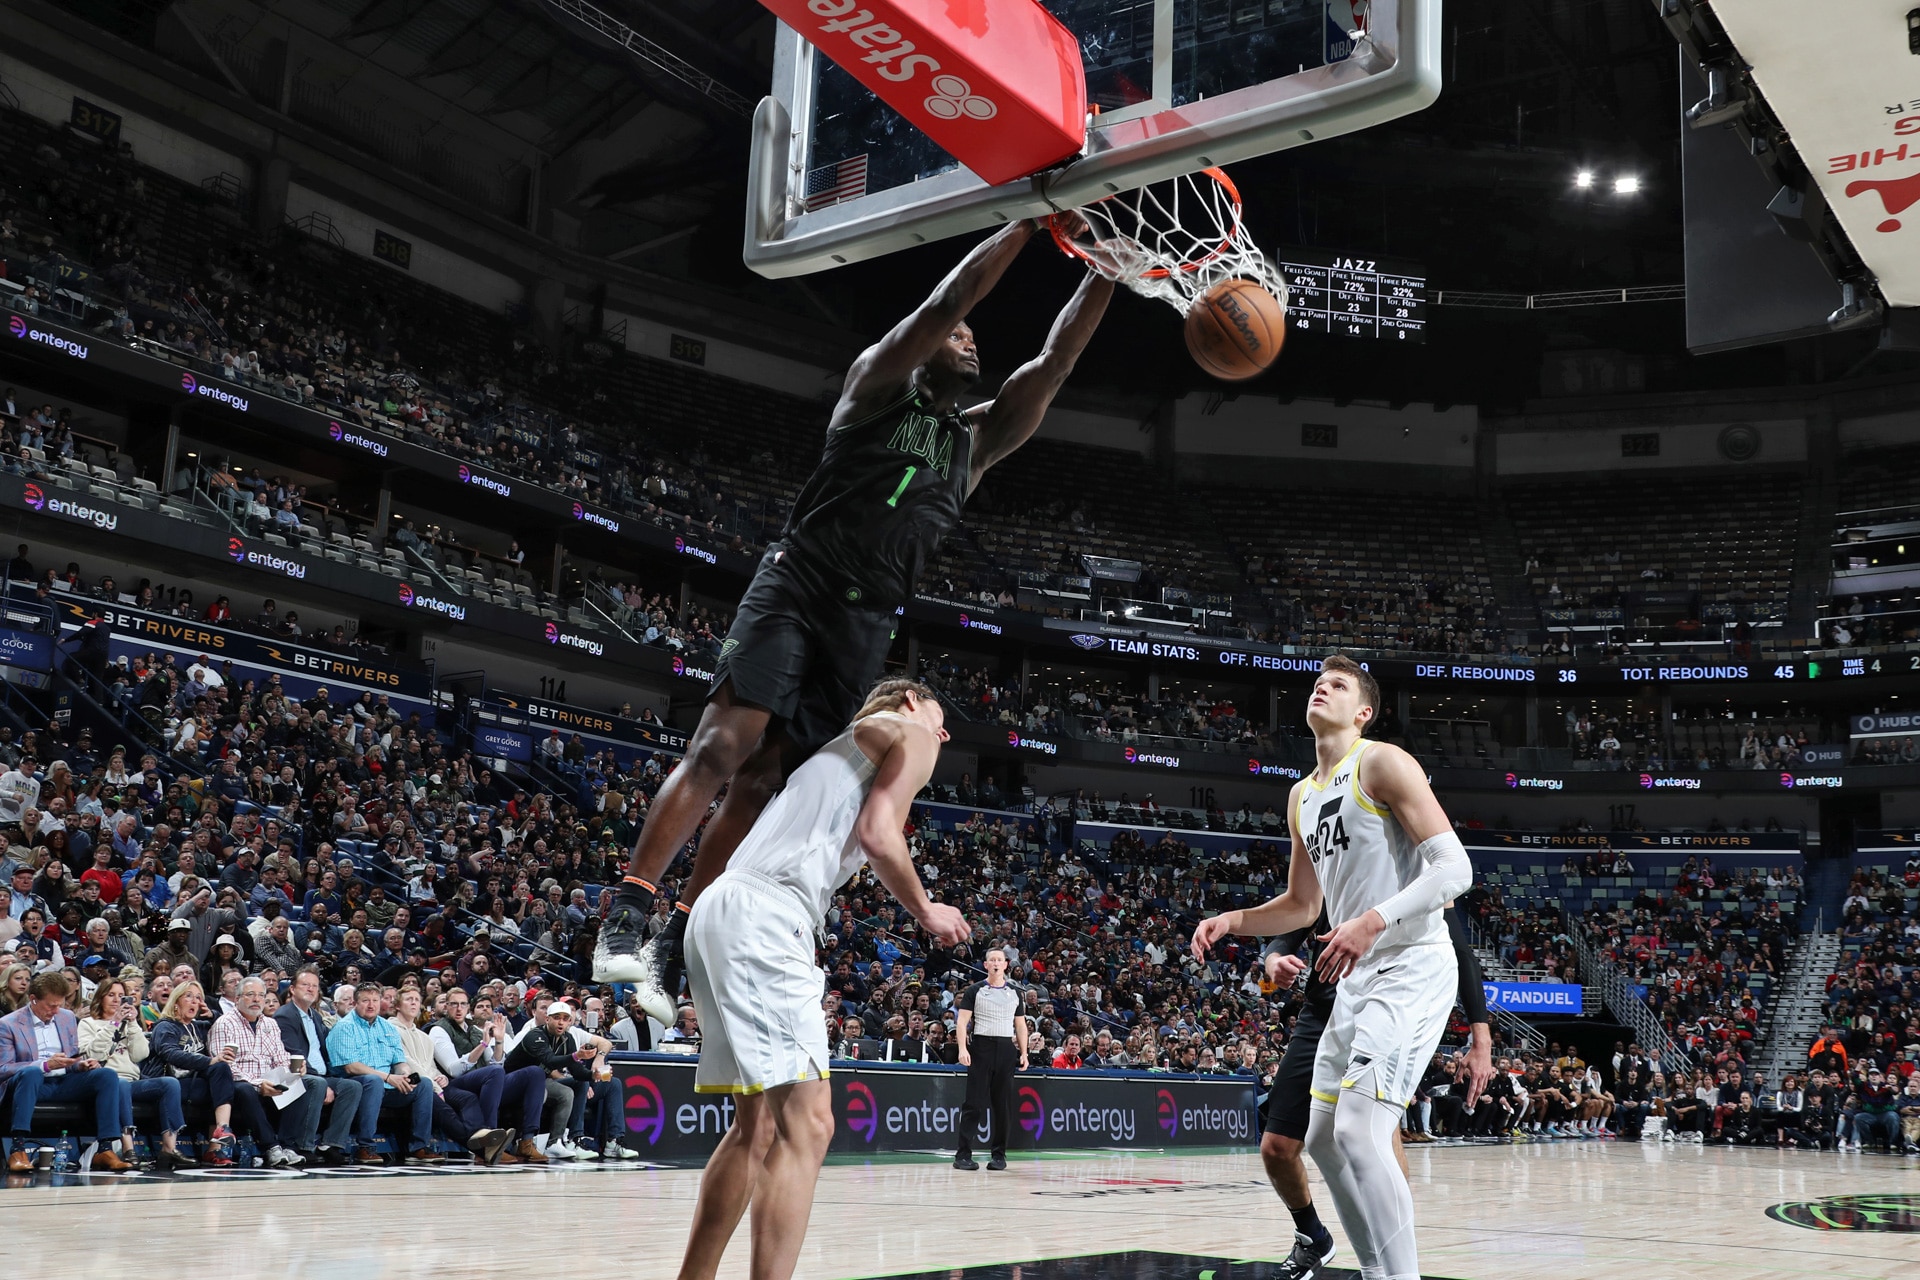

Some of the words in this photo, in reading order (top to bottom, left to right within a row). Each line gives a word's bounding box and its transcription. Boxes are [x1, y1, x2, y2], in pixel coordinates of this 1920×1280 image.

[807, 0, 941, 82] State
[1330, 40, 1352, 60] NBA
[76, 105, 117, 137] 317
[378, 237, 409, 262] 318
[59, 264, 74, 278] 17
[1284, 265, 1303, 274] FIELD
[1304, 268, 1326, 277] GOALS
[1332, 257, 1376, 273] JAZZ
[1294, 276, 1317, 287] 47%
[1331, 271, 1348, 280] FREE
[1350, 273, 1377, 283] THROWS
[1380, 276, 1400, 286] THREE
[1401, 279, 1425, 289] POINTS
[1304, 288, 1320, 296] REB
[1344, 281, 1365, 293] 72%
[1392, 287, 1414, 298] 32%
[1298, 298, 1306, 306] 5
[1356, 294, 1370, 302] REB
[1402, 300, 1417, 308] REB
[1308, 310, 1327, 319] PAINT
[1347, 303, 1361, 313] 23
[1395, 308, 1409, 318] 28
[1216, 291, 1261, 352] Wilson
[1296, 319, 1310, 329] 48
[1333, 314, 1350, 322] FAST
[1351, 316, 1373, 325] BREAK
[1381, 318, 1395, 327] 2ND
[1396, 321, 1422, 330] CHANCE
[1348, 325, 1361, 335] 14
[1398, 330, 1406, 340] 8
[29, 328, 88, 359] entergy
[675, 339, 703, 359] 319
[198, 384, 249, 411] entergy
[344, 432, 388, 457] entergy
[523, 432, 540, 446] 317
[887, 411, 954, 480] NOLA
[574, 451, 591, 464] 318
[471, 473, 511, 497] entergy
[887, 465, 917, 507] 1
[674, 487, 689, 499] 318
[48, 498, 118, 531] entergy
[584, 511, 619, 533] entergy
[685, 544, 717, 564] entergy
[247, 549, 306, 579] entergy
[1065, 577, 1082, 586] 320
[1173, 590, 1189, 600] 320
[415, 595, 466, 621] entergy
[1595, 609, 1613, 618] 322
[103, 611, 226, 649] BETRIVERS
[969, 620, 1002, 635] entergy
[2, 638, 34, 651] GOOSE
[425, 640, 436, 652] 114
[559, 633, 604, 656] entergy
[1108, 638, 1149, 655] TEAM
[1152, 643, 1200, 661] STATS:
[1219, 651, 1249, 666] OFF.
[1253, 655, 1322, 672] REBOUND
[293, 653, 400, 686] BETRIVERS
[1620, 667, 1654, 681] TOT.
[1659, 666, 1749, 680] REBOUNDS
[1774, 665, 1795, 679] 45
[1842, 658, 1865, 668] TIME
[1870, 659, 1882, 673] 4
[1842, 667, 1865, 676] OUTS
[20, 670, 39, 686] 113
[685, 666, 716, 684] enter
[1415, 665, 1447, 679] DEF.
[1451, 667, 1536, 682] REBOUNDS
[1557, 669, 1577, 683] 36
[539, 675, 566, 702] 114
[528, 703, 614, 732] BETRIVERS
[1879, 716, 1910, 728] HUB
[485, 735, 501, 744] GREY
[501, 738, 521, 748] GOOSE
[1020, 738, 1057, 755] entergy
[1138, 752, 1180, 768] entergy
[1819, 751, 1842, 760] HUB
[1261, 764, 1301, 779] entergy
[1519, 777, 1564, 790] entergy
[1654, 775, 1701, 790] entergy
[1795, 774, 1843, 789] entergy
[1190, 786, 1215, 808] 116
[1608, 804, 1636, 823] 117
[1320, 815, 1350, 857] 24
[1521, 835, 1609, 845] BETRIVERS
[1660, 836, 1751, 846] BETRIVERS
[1502, 990, 1574, 1005] FANDUEL
[885, 1099, 991, 1144] entery
[1051, 1102, 1136, 1142] entergy
[1182, 1103, 1249, 1140] entergy
